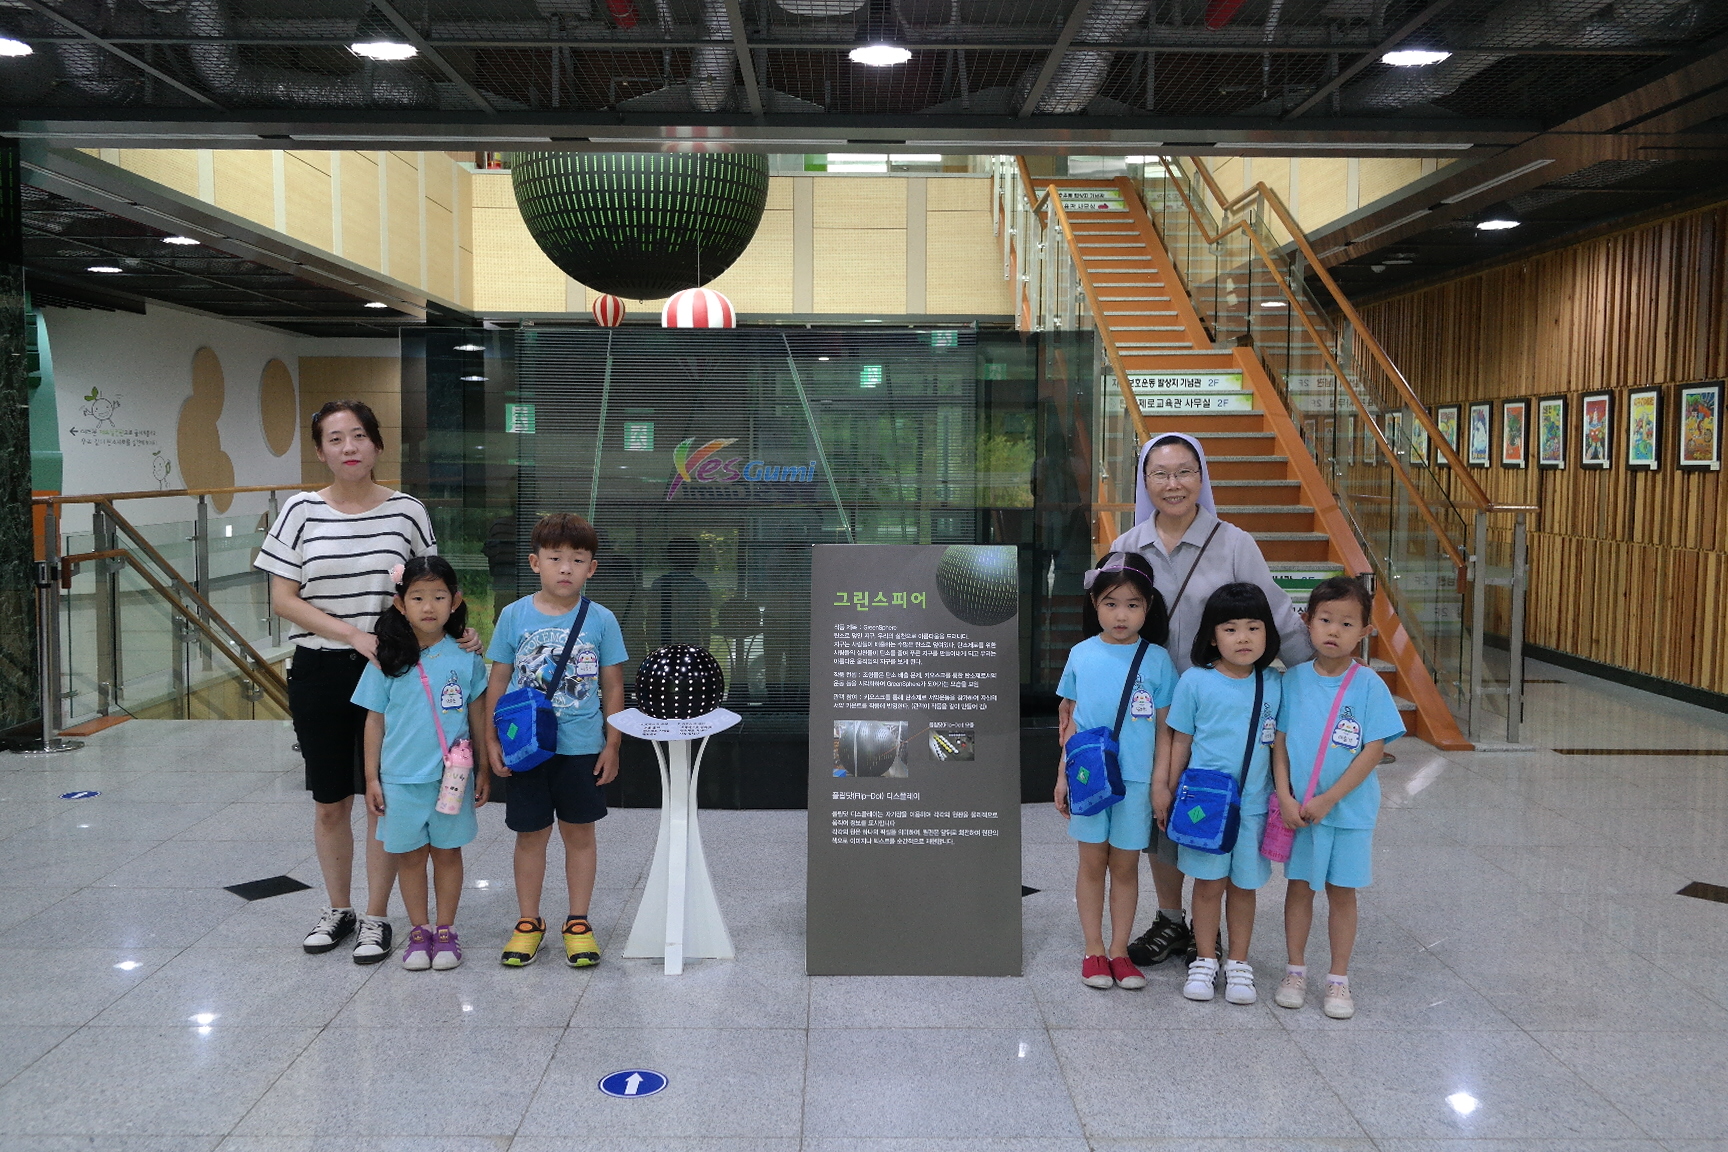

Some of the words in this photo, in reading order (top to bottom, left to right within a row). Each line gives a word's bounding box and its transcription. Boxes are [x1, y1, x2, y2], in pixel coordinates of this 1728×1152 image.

[1158, 378, 1179, 388] 발상지
[1180, 378, 1202, 388] 기념관
[1185, 398, 1211, 408] 사무실
[666, 436, 742, 501] Yes
[743, 460, 816, 482] Gumi
[834, 592, 926, 611] 그린스피어
[887, 792, 920, 800] 디스플레이
